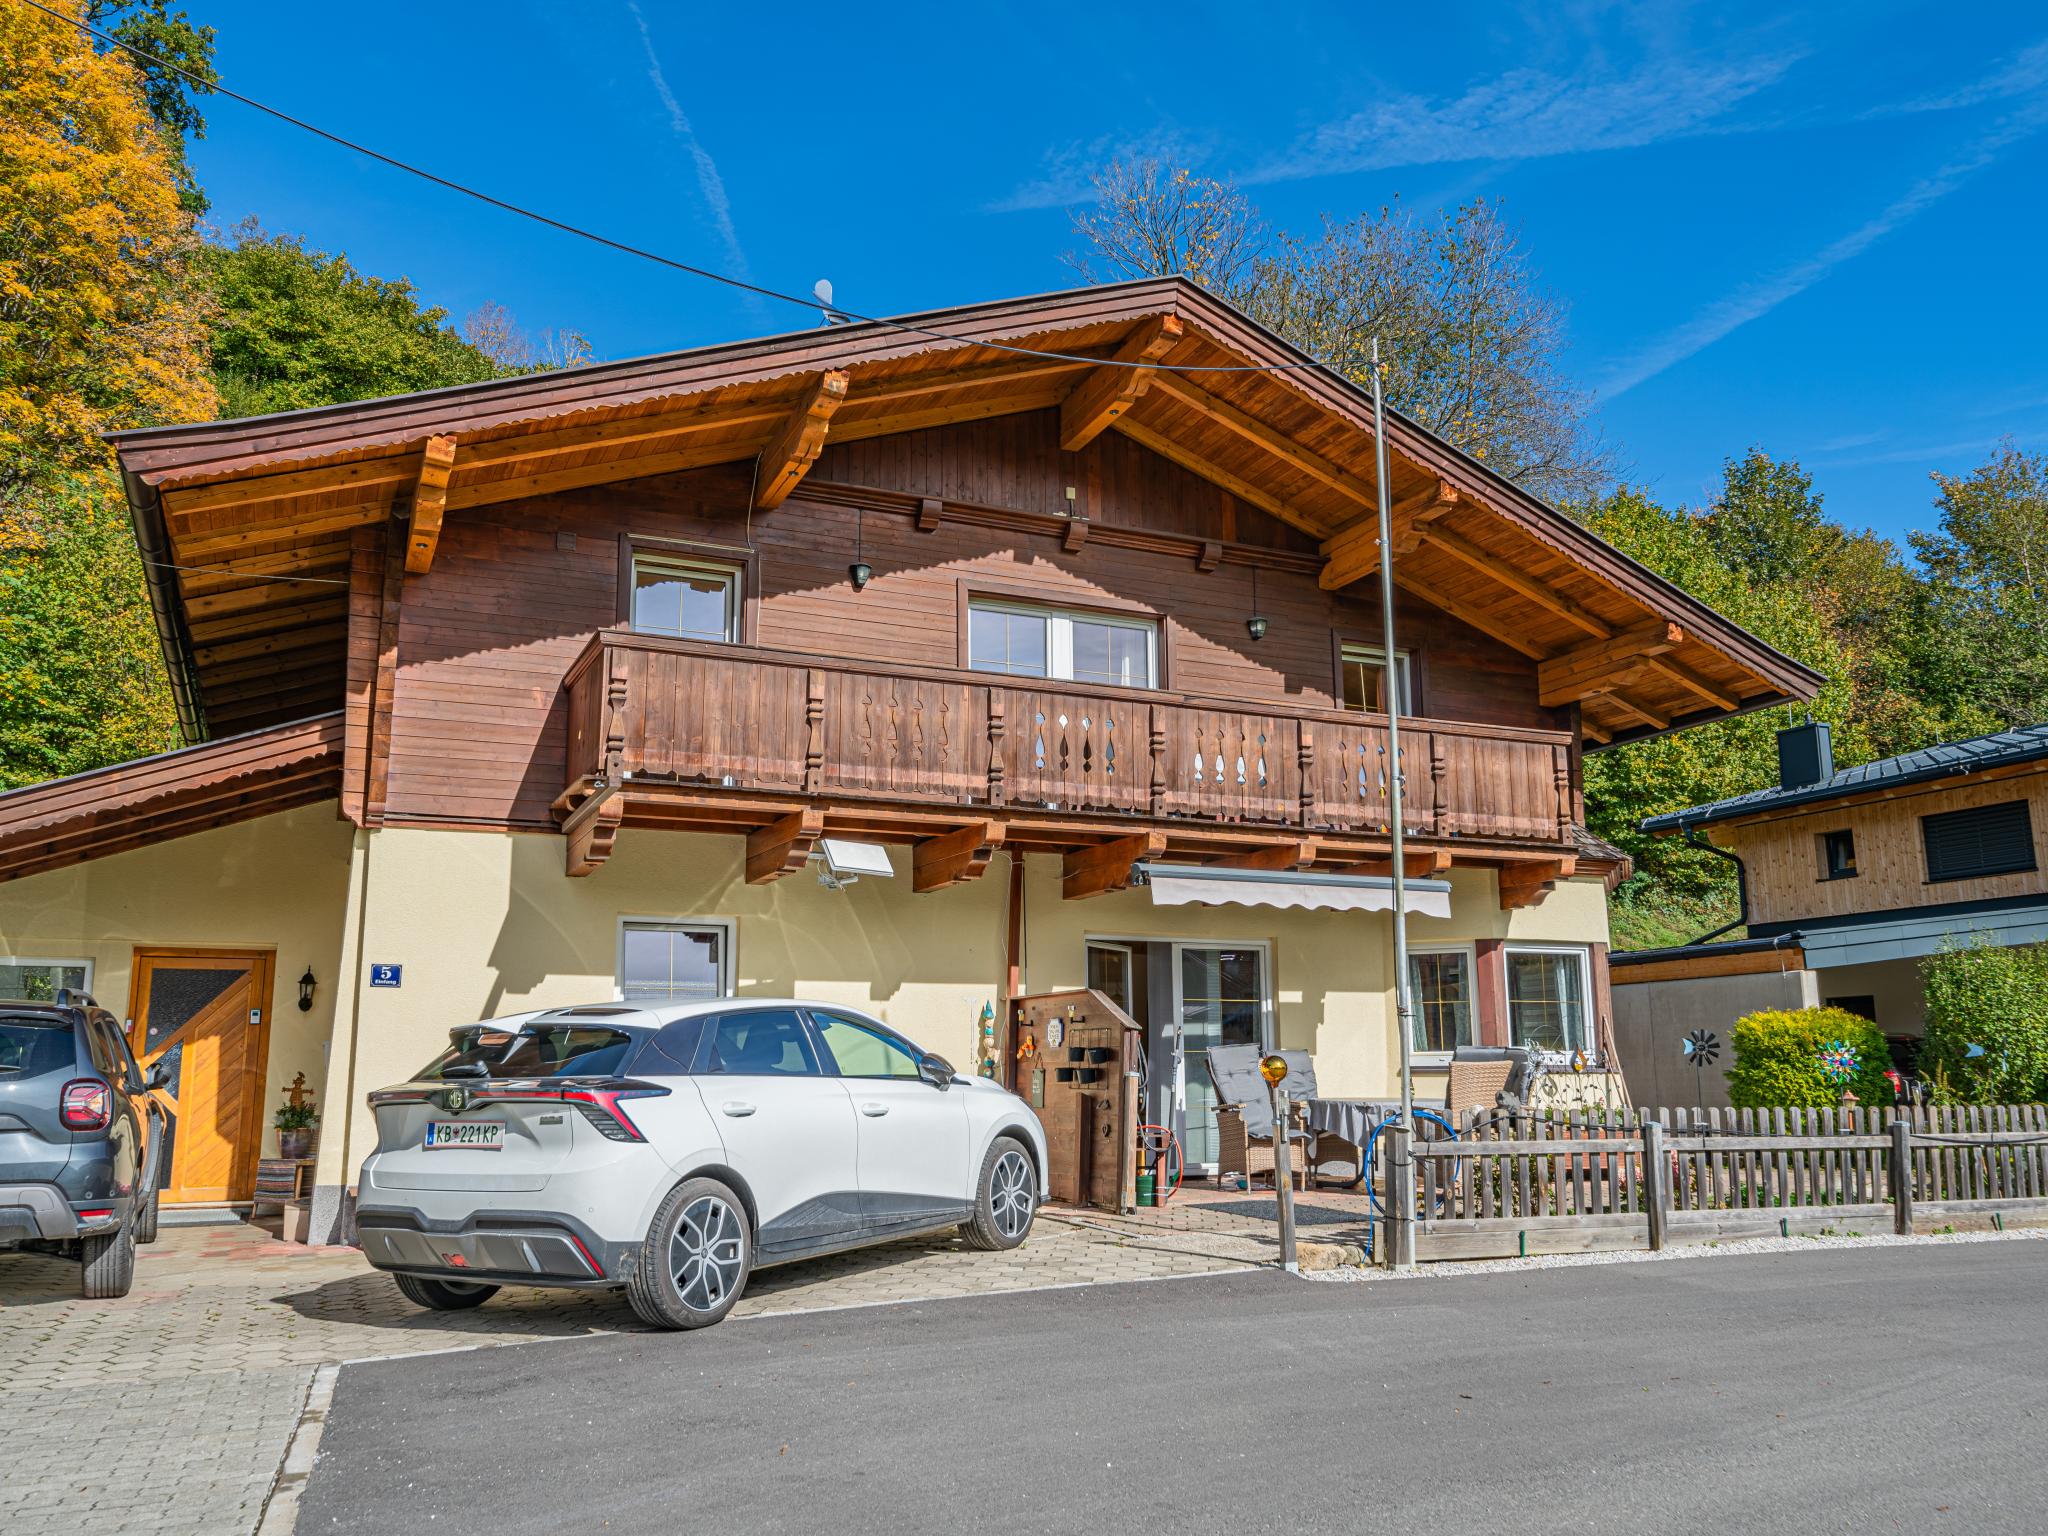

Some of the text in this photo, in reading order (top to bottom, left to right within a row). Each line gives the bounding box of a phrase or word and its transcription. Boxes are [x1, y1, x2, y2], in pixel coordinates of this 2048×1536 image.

[380, 966, 392, 979] 5
[449, 1090, 462, 1108] MG
[436, 1125, 499, 1143] KB 221KP
